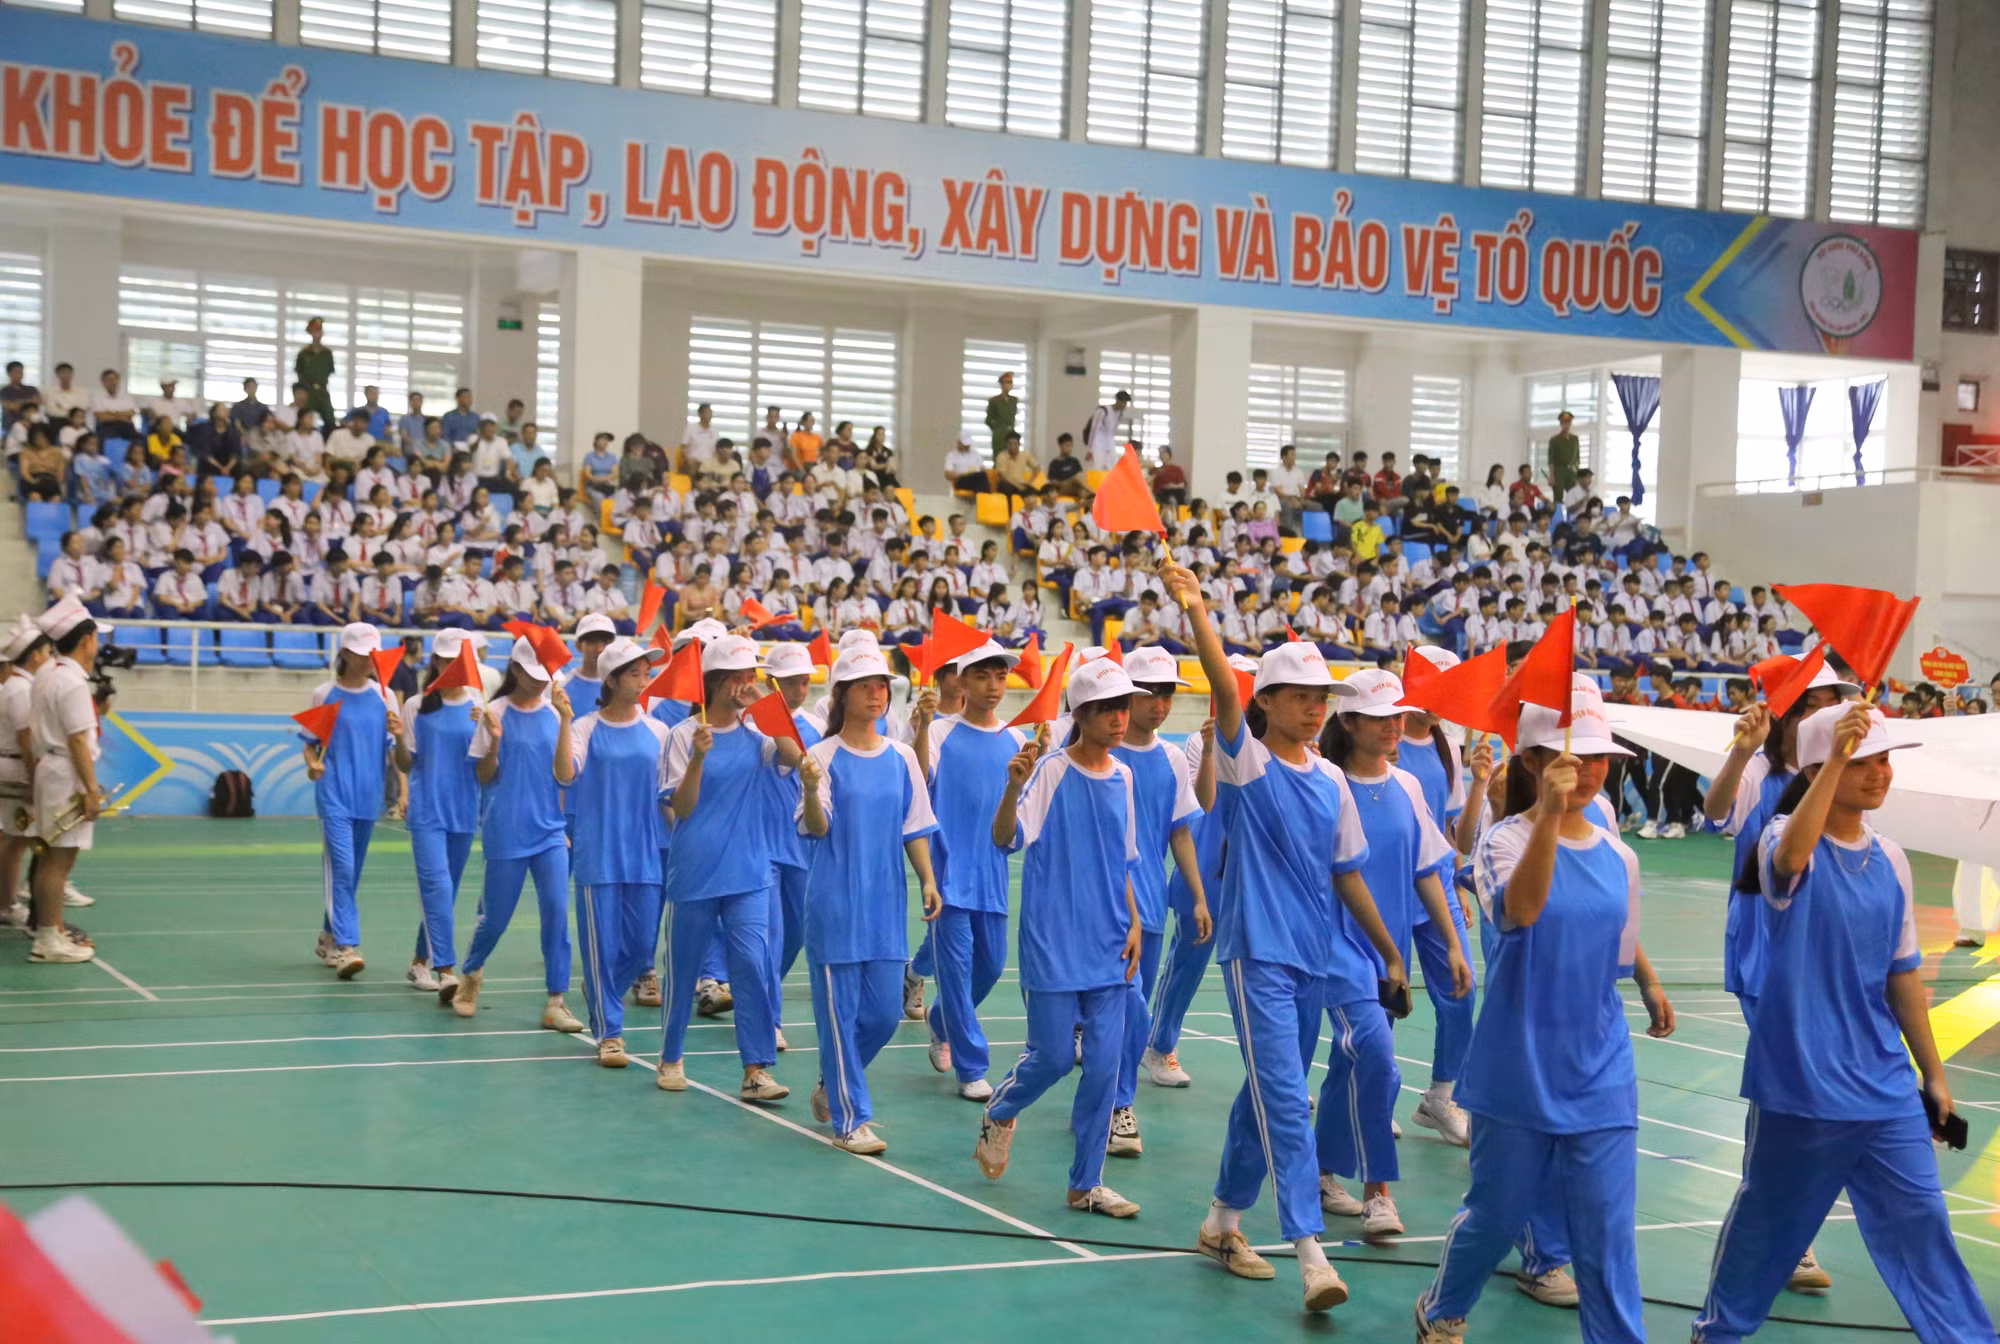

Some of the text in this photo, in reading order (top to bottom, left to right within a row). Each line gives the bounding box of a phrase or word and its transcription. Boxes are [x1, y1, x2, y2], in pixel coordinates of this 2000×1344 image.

[1, 43, 1663, 315] KHỎE ĐỂ HỌC TẬP, LAO ĐỘNG, XÂY DỰNG VÀ BẢO VỆ TỔ QUỐC
